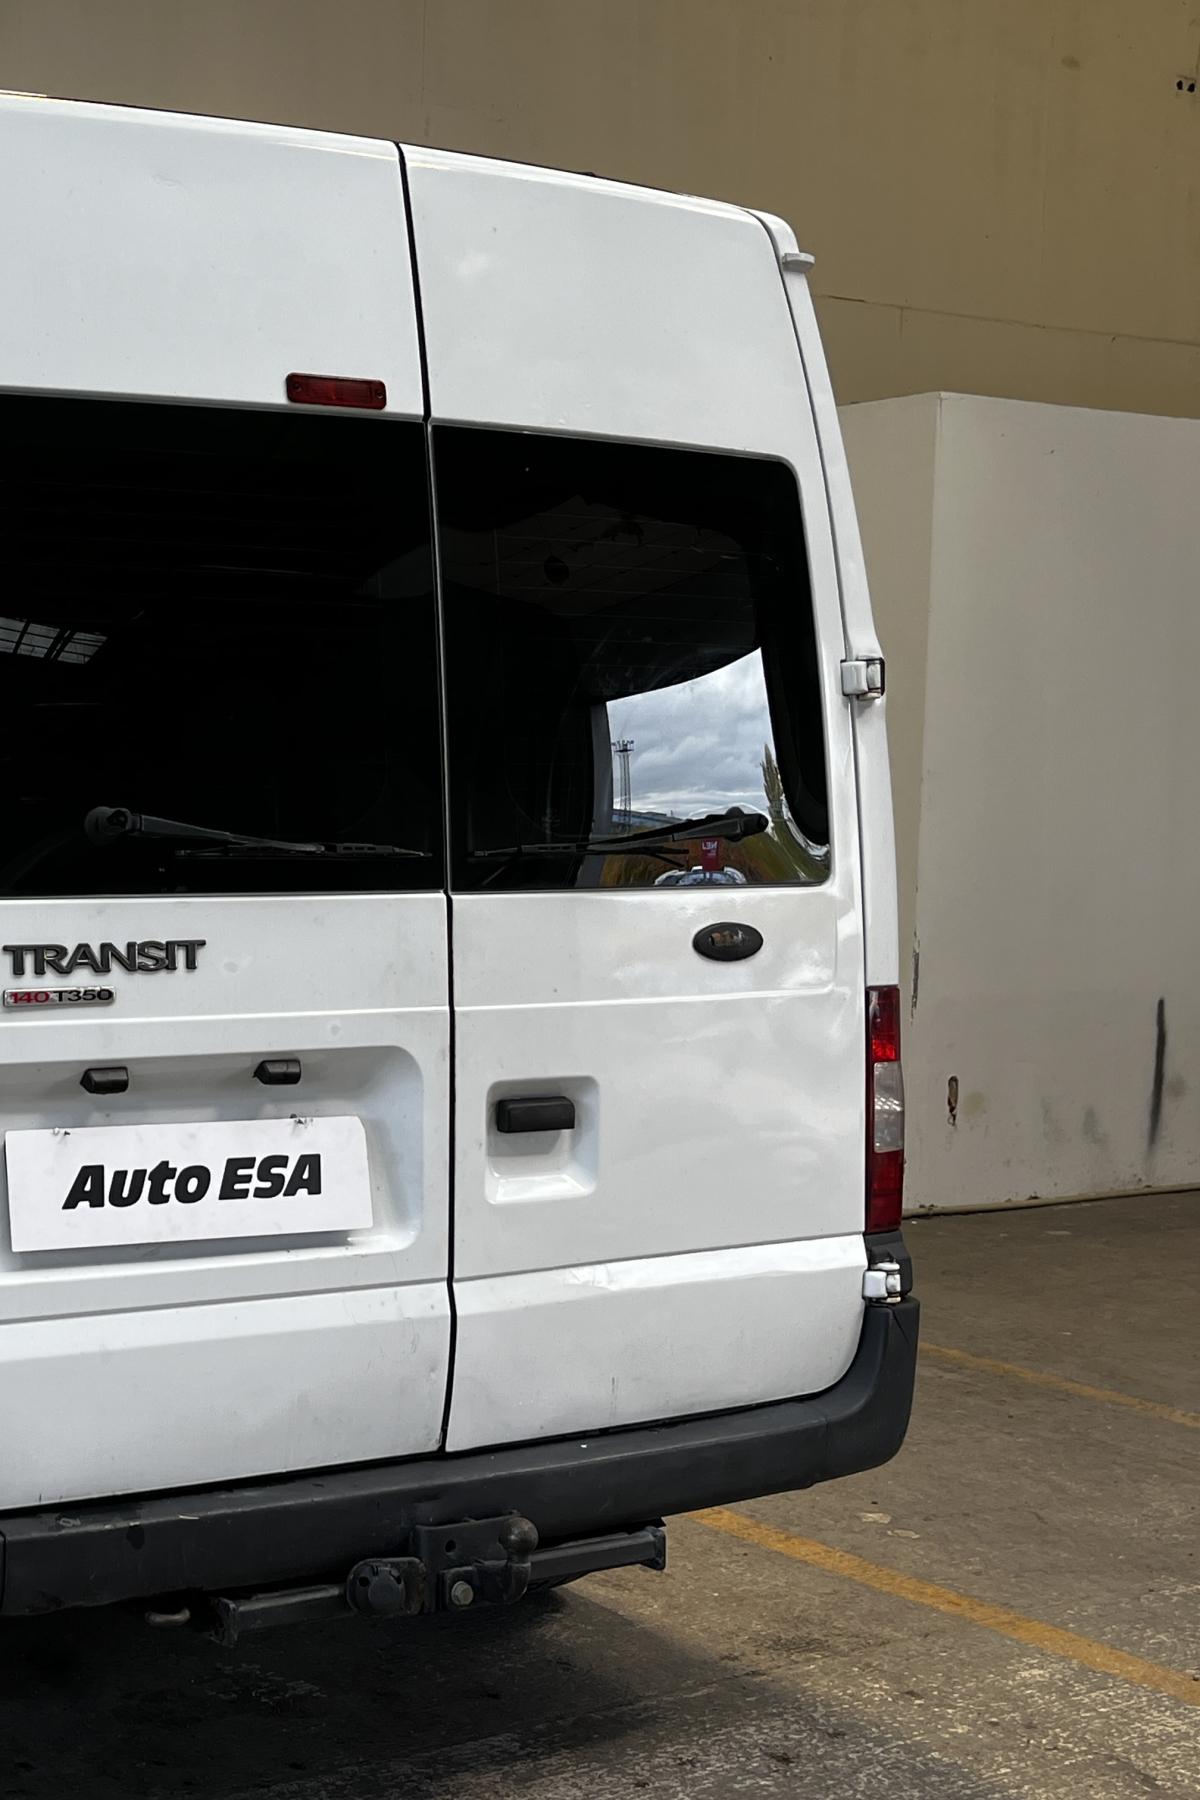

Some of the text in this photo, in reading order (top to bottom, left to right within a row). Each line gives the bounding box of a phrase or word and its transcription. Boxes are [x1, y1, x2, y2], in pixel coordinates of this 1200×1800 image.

[2, 939, 206, 975] TRANSIT
[8, 988, 115, 1004] 140 T350
[61, 1153, 322, 1210] Auto ESA
